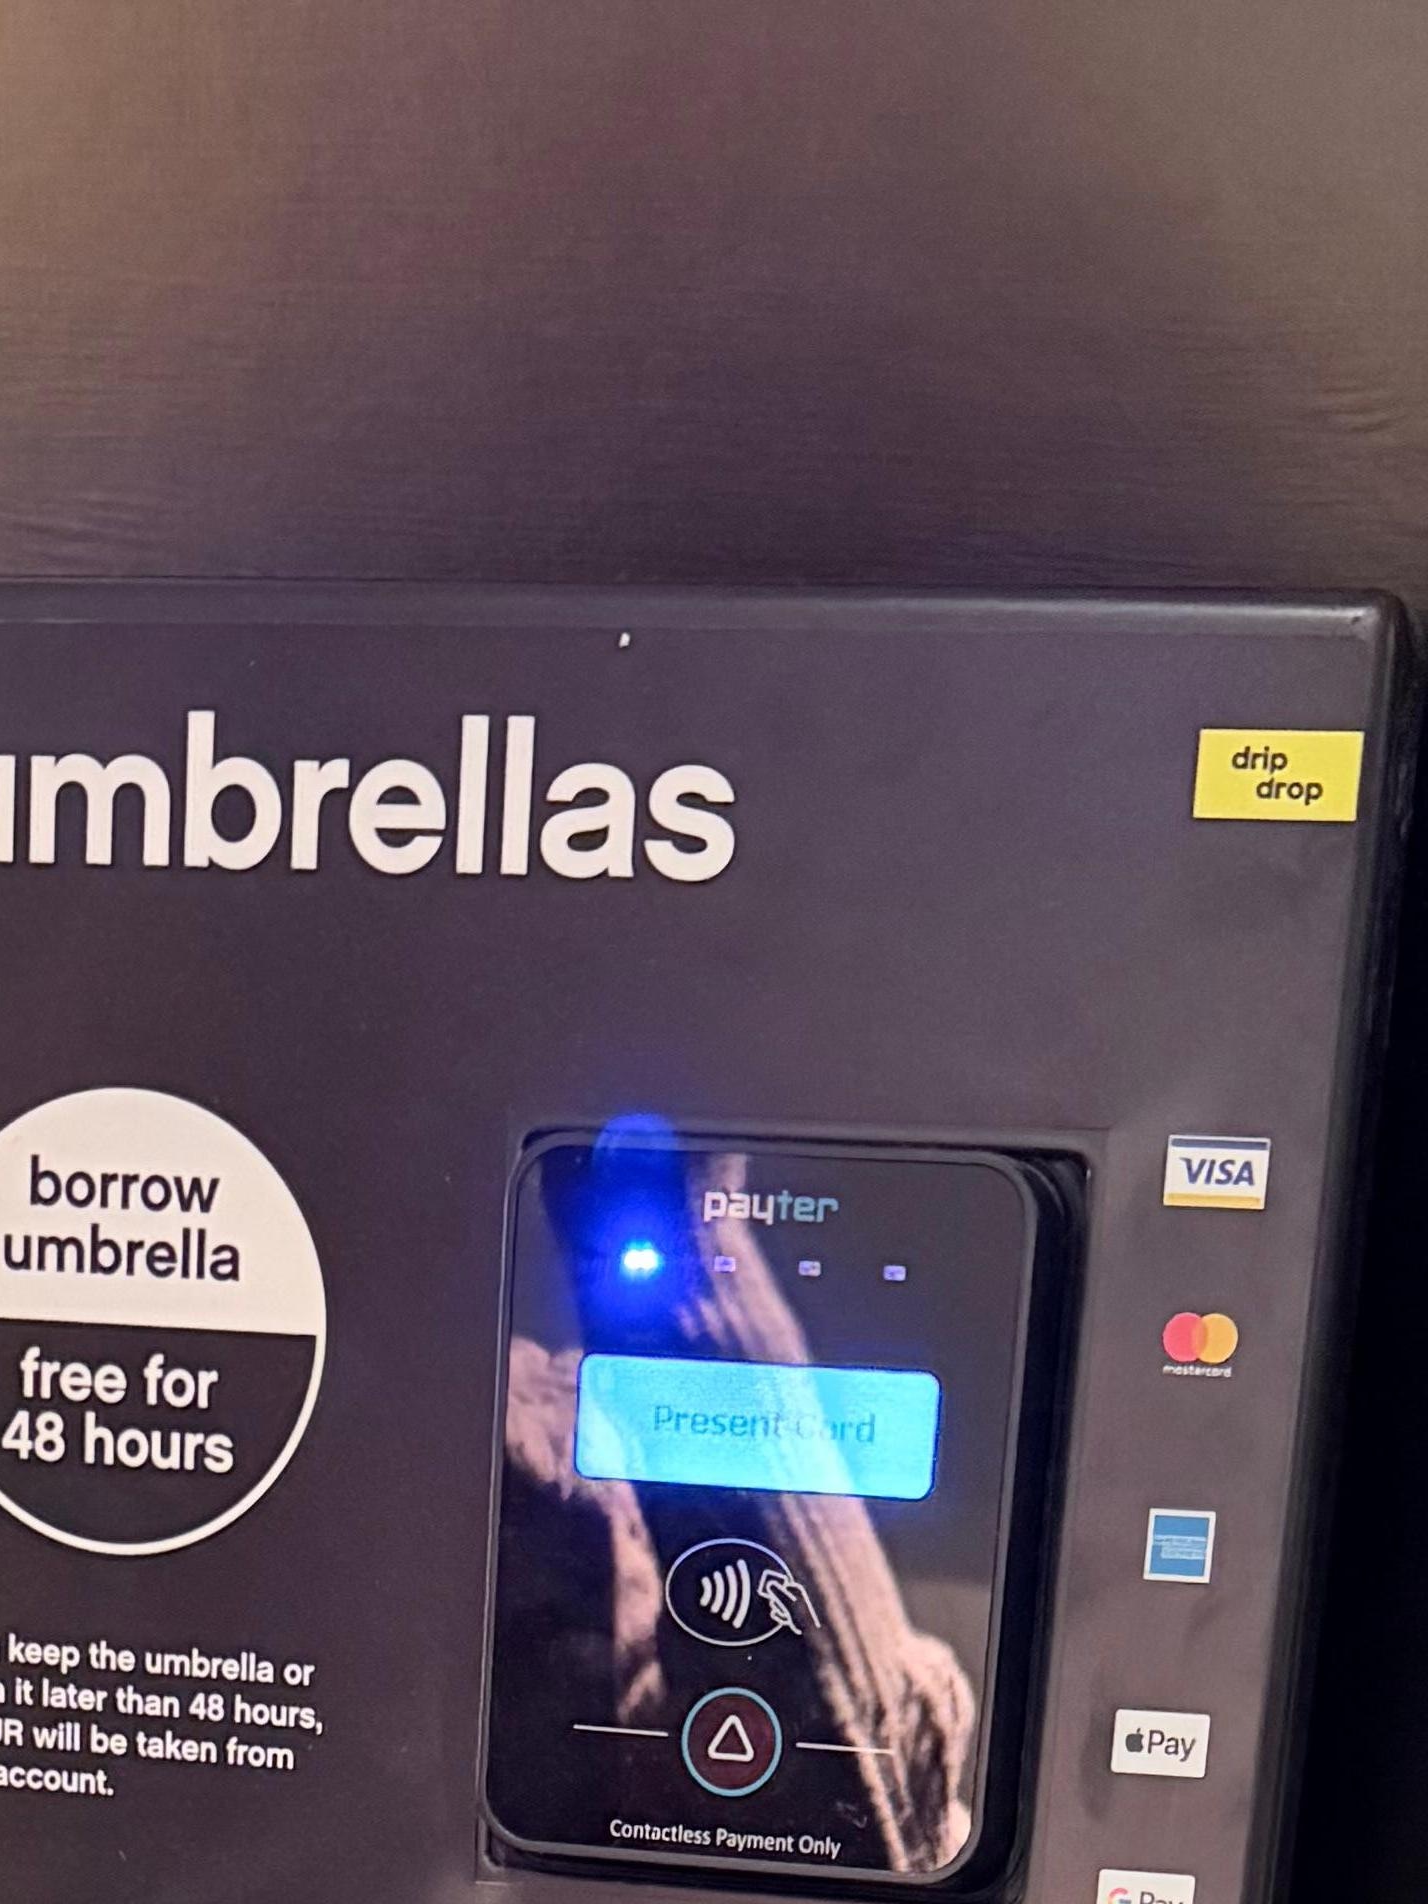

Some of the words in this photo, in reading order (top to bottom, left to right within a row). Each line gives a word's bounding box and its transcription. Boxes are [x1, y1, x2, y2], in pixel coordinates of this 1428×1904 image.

[1231, 745, 1288, 774] drip
[1256, 777, 1324, 806] drop
[30, 1154, 220, 1214] borrow
[1181, 1157, 1255, 1186] VISA
[702, 1189, 840, 1226] payter
[4, 1222, 240, 1282] umbrella
[20, 1346, 127, 1404] free
[143, 1353, 219, 1409] for
[1, 1410, 66, 1462] 48
[84, 1410, 234, 1473] hours
[654, 1404, 782, 1438] Present
[8, 1633, 81, 1675] keep
[88, 1640, 136, 1672] the
[145, 1647, 274, 1683] umbrella
[283, 1663, 316, 1686] or
[15, 1677, 34, 1706] it
[42, 1677, 108, 1712] later
[115, 1684, 180, 1718] than
[188, 1692, 225, 1722] 48
[234, 1693, 323, 1735] hours,
[32, 1721, 81, 1752] will
[90, 1723, 128, 1756] be
[136, 1730, 217, 1763] taken
[226, 1736, 294, 1770] from
[1147, 1729, 1196, 1762] Pay
[609, 1819, 712, 1846] Contactless
[715, 1827, 795, 1853] Payment
[798, 1835, 842, 1860] Only
